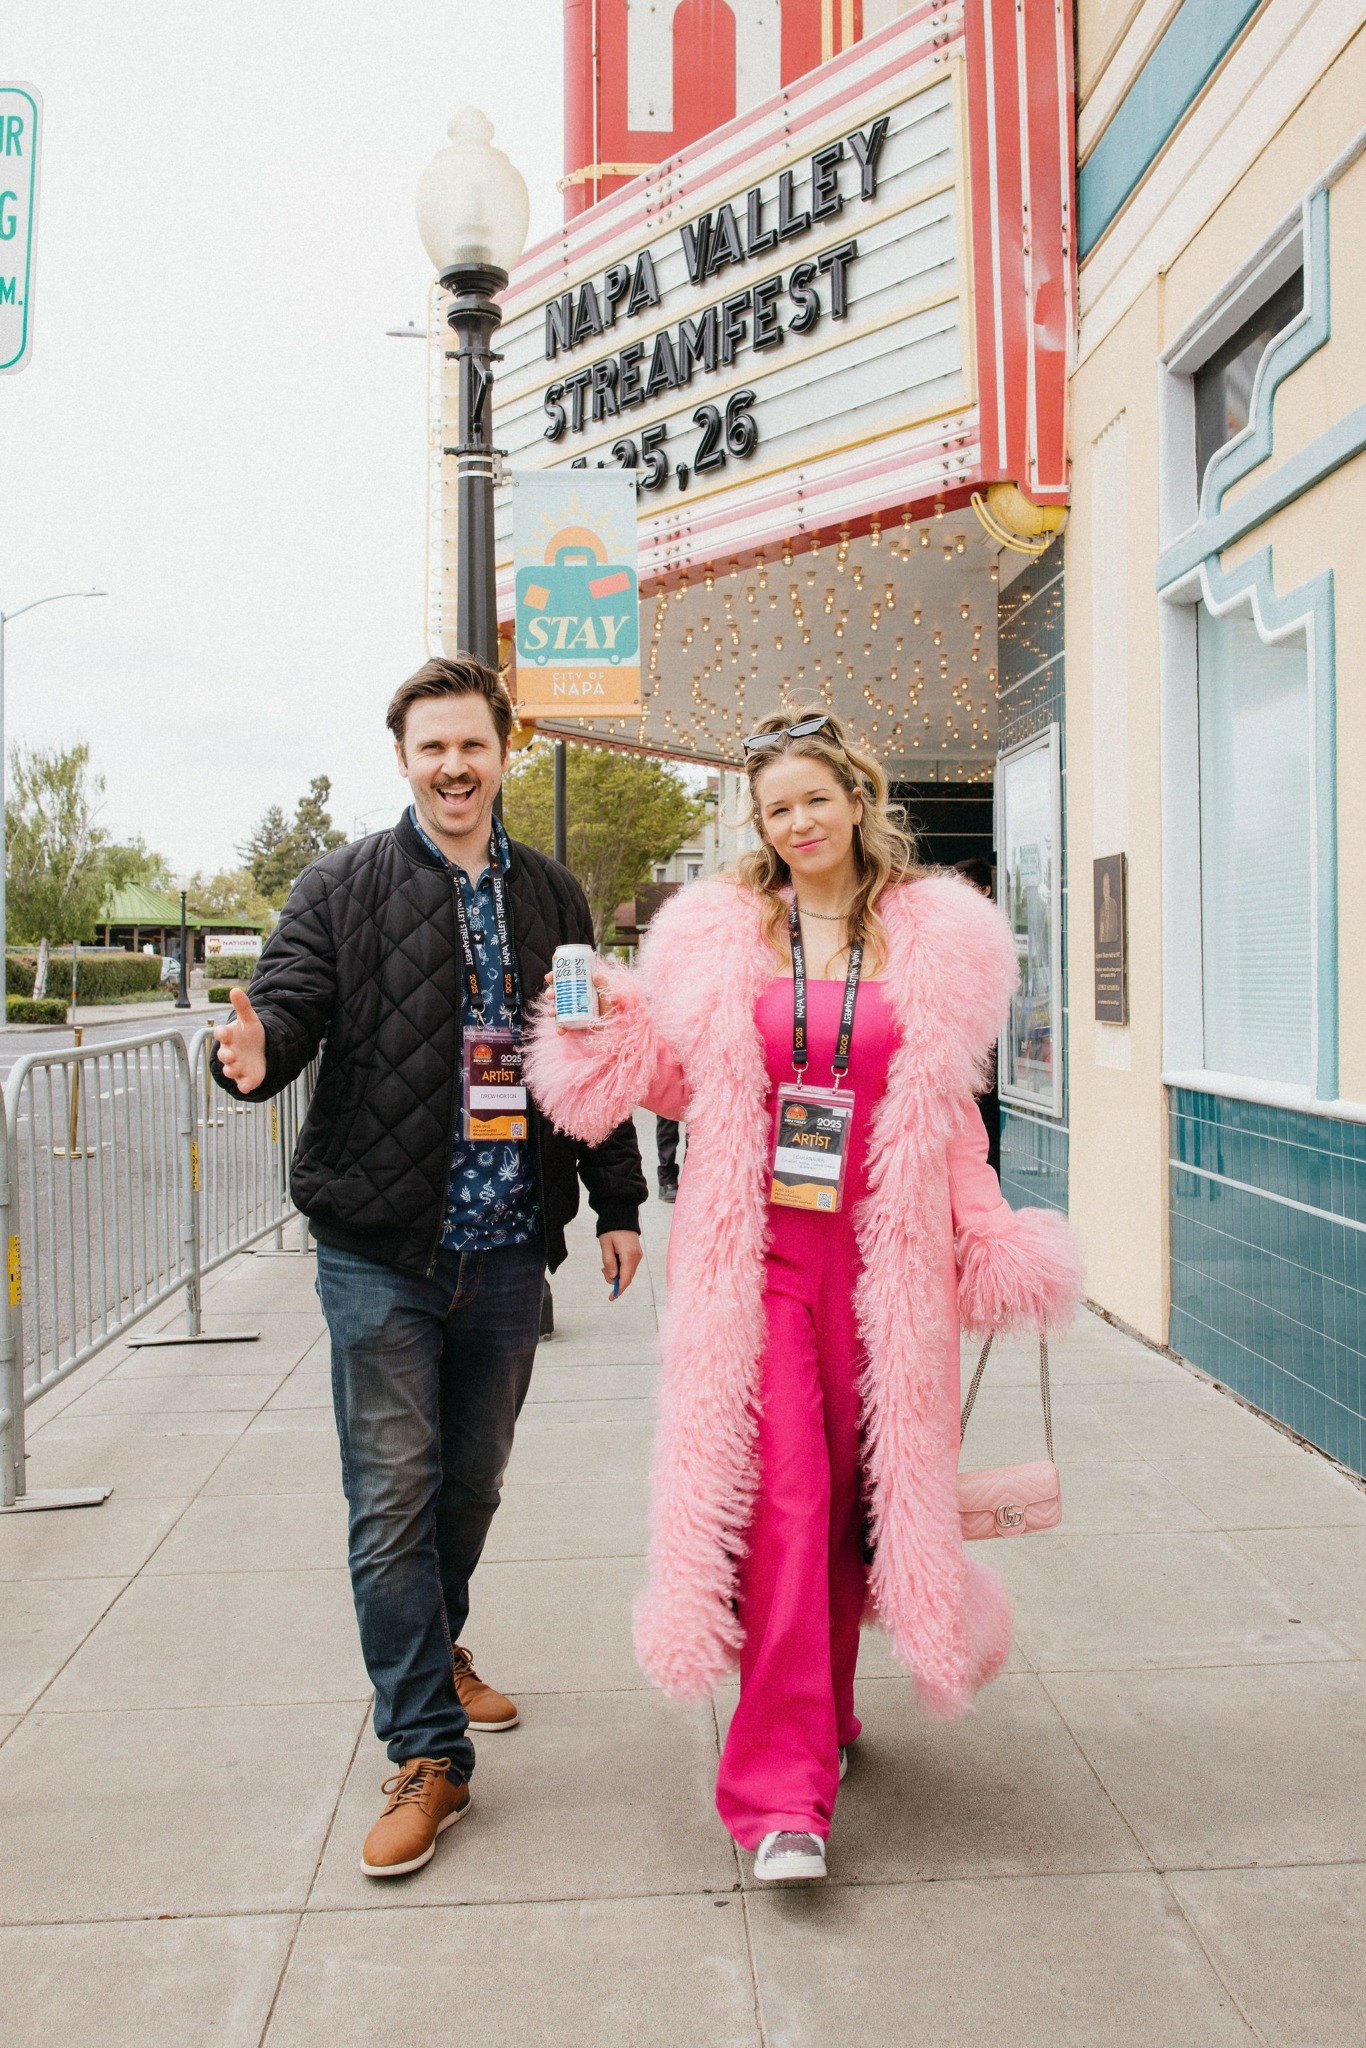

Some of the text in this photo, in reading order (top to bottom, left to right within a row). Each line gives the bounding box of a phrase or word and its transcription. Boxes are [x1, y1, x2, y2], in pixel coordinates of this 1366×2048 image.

[0, 116, 24, 156] R
[545, 116, 890, 361] NAPA VALLEY
[544, 239, 859, 442] STREAMFEST
[524, 616, 631, 650] STAY
[552, 671, 605, 680] CITY OF
[553, 681, 605, 696] NAPA
[460, 923, 474, 966] STREAMFEST
[469, 973, 479, 994] 2025
[493, 877, 512, 994] 2025 NAPA VALLEY STREAMFEST
[793, 945, 806, 1049] 2025 NAPA VALLEY STREAMFEST
[839, 949, 862, 1055] NAPA VALLEY STREAMFEST 2025
[500, 1054, 522, 1063] 2025
[816, 1117, 842, 1129] 2025
